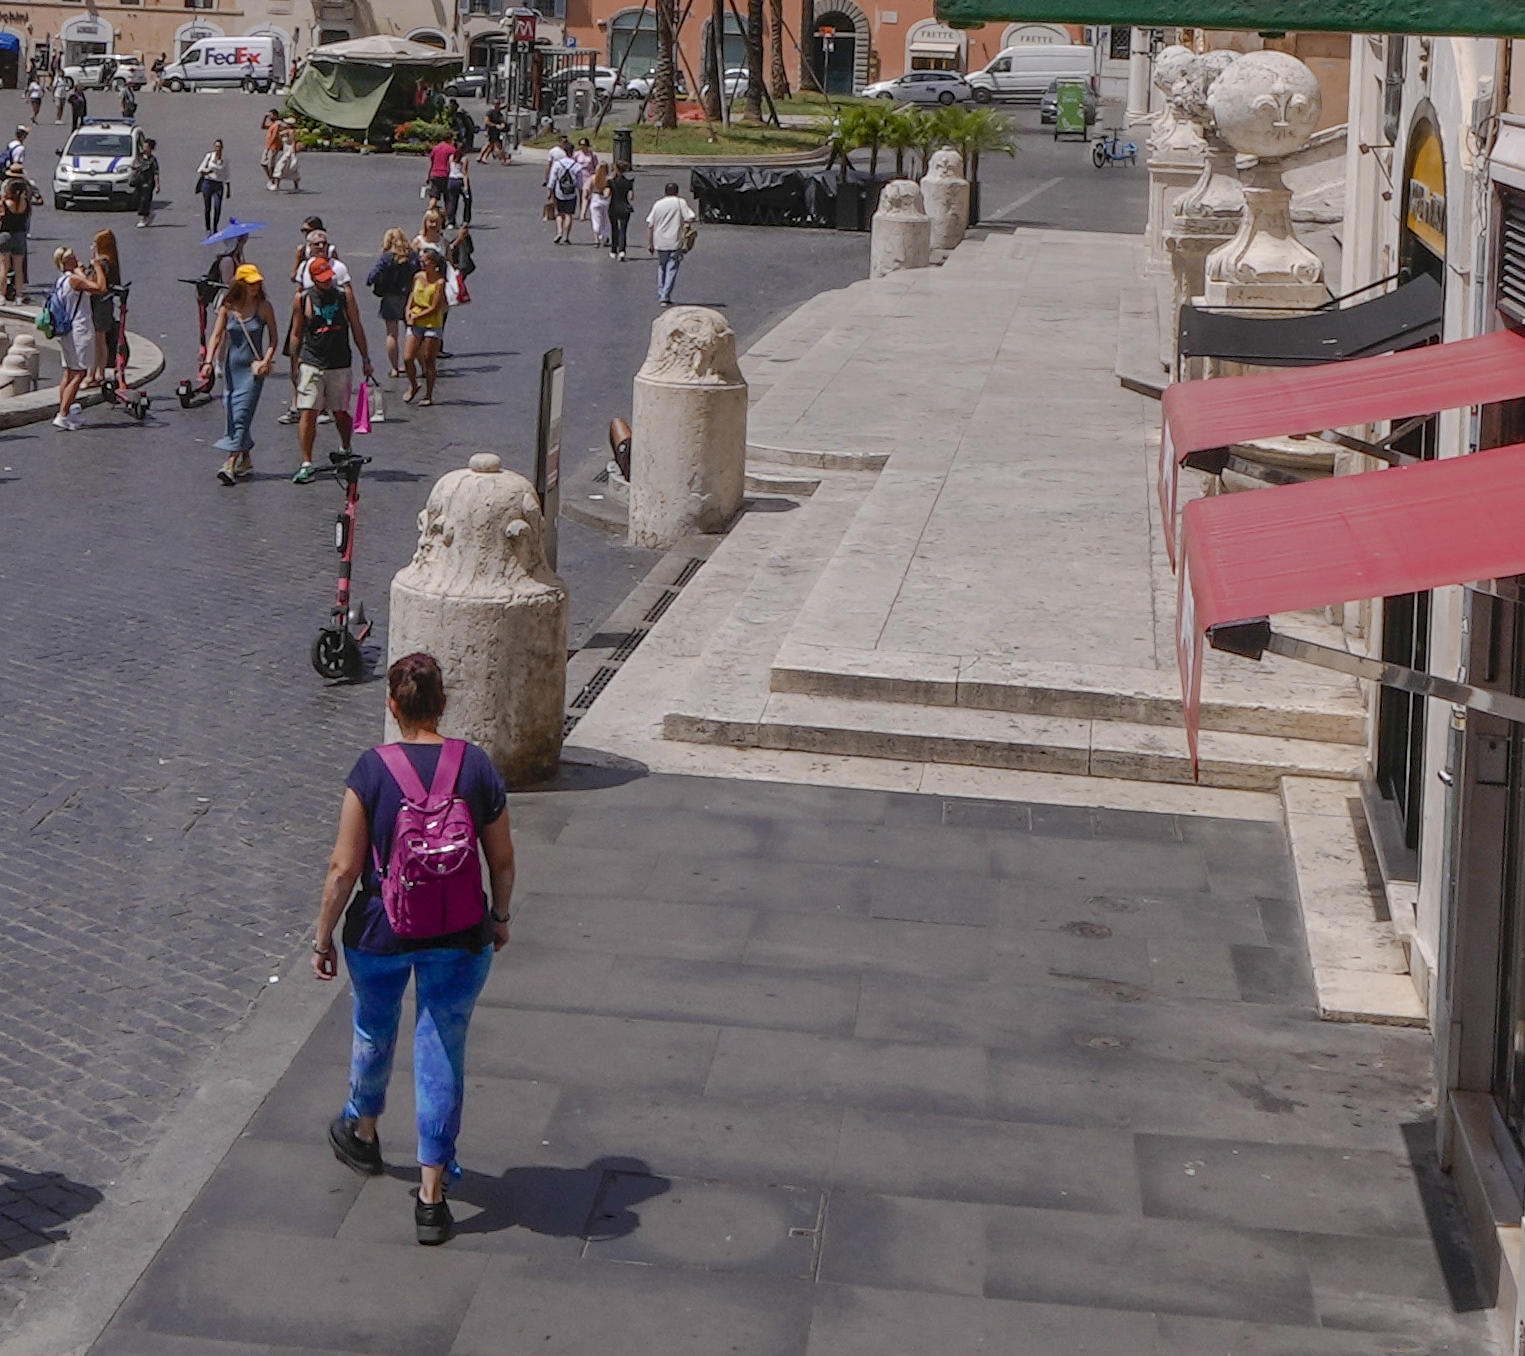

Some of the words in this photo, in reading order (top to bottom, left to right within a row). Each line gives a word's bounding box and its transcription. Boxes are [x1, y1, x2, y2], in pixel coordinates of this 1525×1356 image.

[921, 30, 954, 39] FRETTE
[1020, 35, 1053, 43] FRETTE
[204, 47, 261, 64] FedEx
